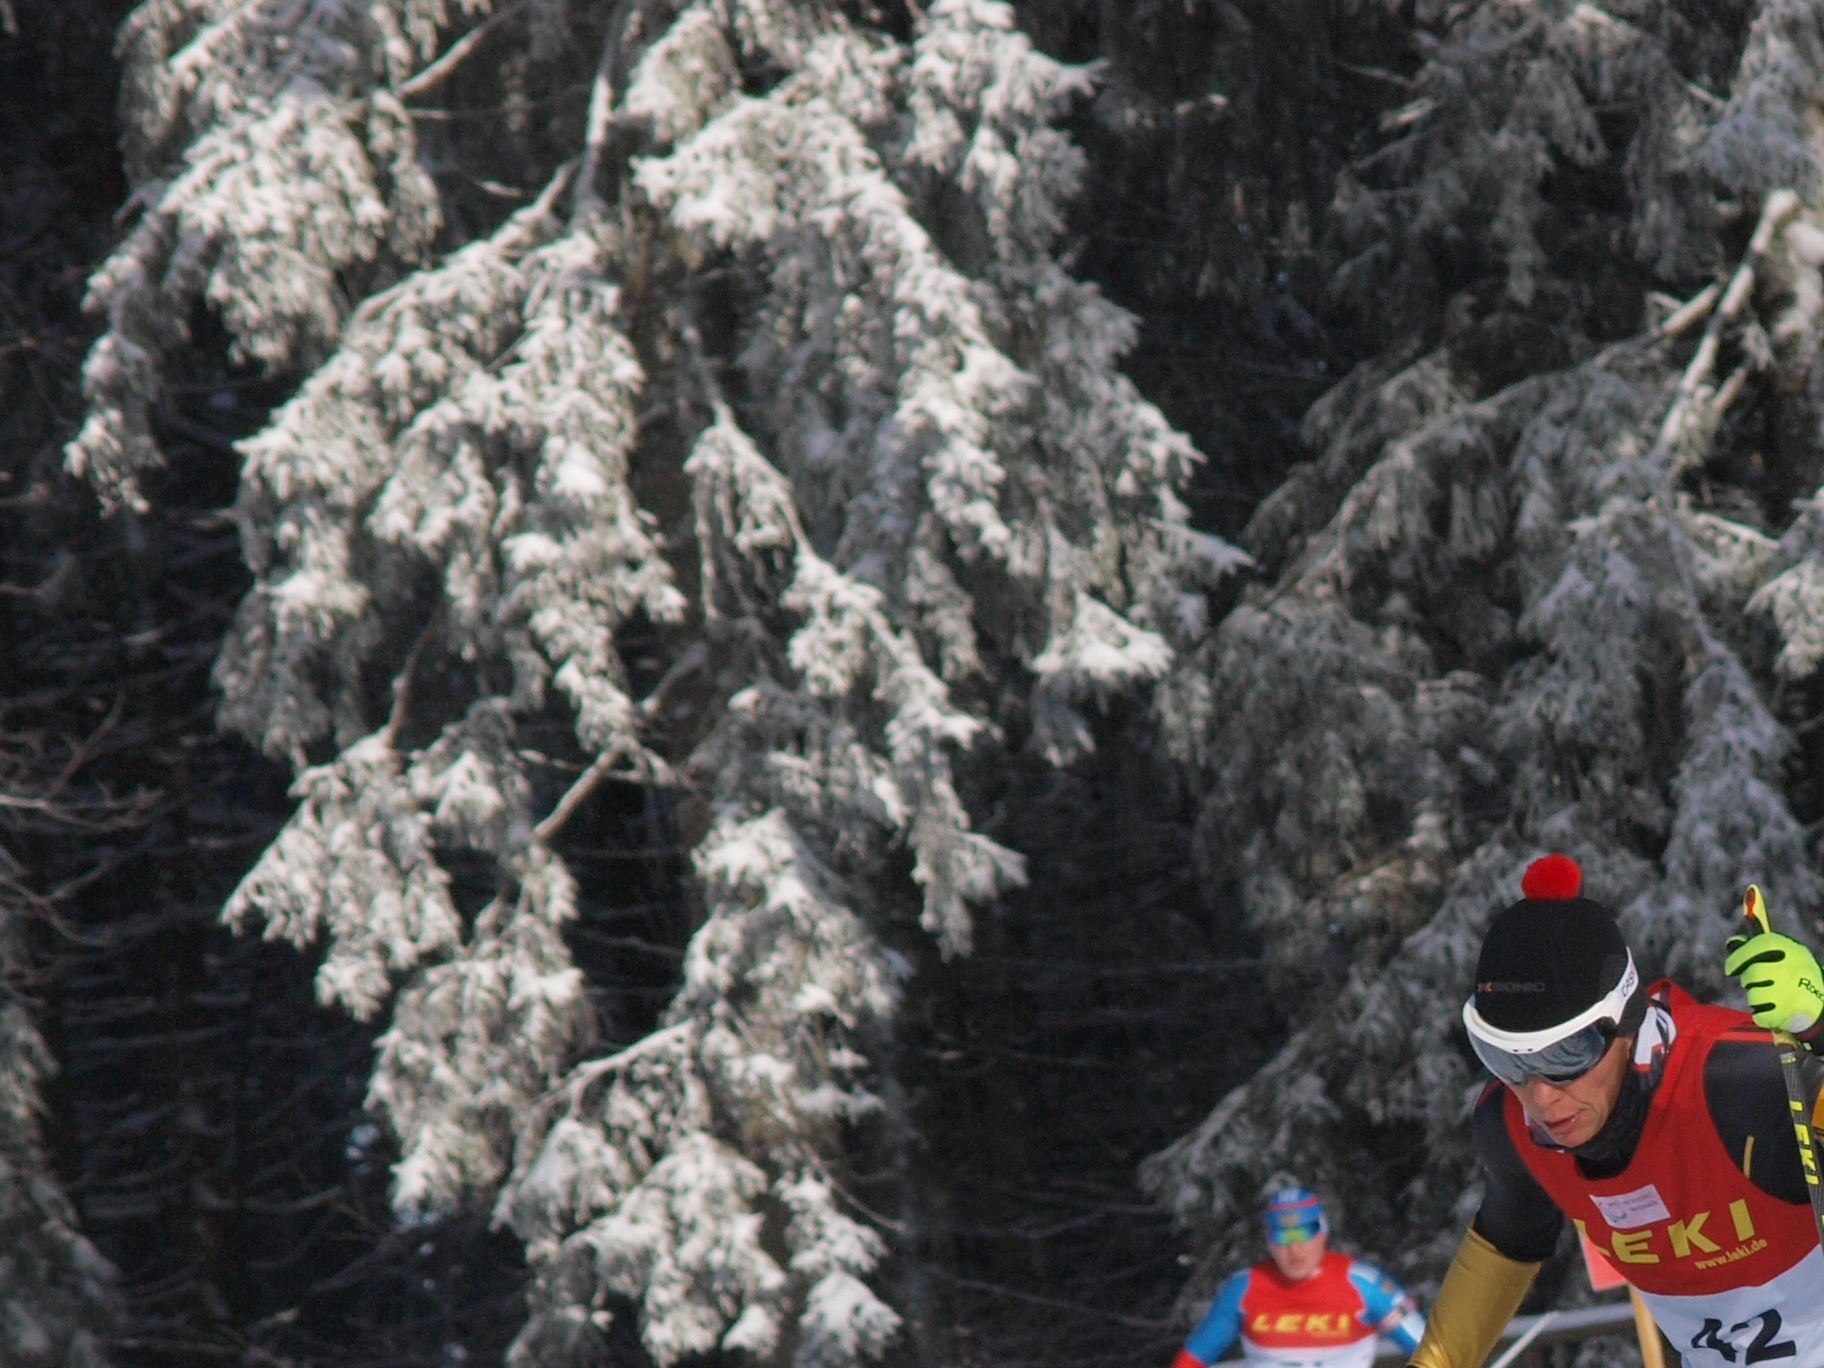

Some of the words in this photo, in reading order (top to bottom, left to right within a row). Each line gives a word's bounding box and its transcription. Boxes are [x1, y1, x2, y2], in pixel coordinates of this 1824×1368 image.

[1695, 1239, 1768, 1270] www.leki.de
[1252, 1314, 1351, 1333] LEKI
[1691, 1308, 1797, 1366] 42
